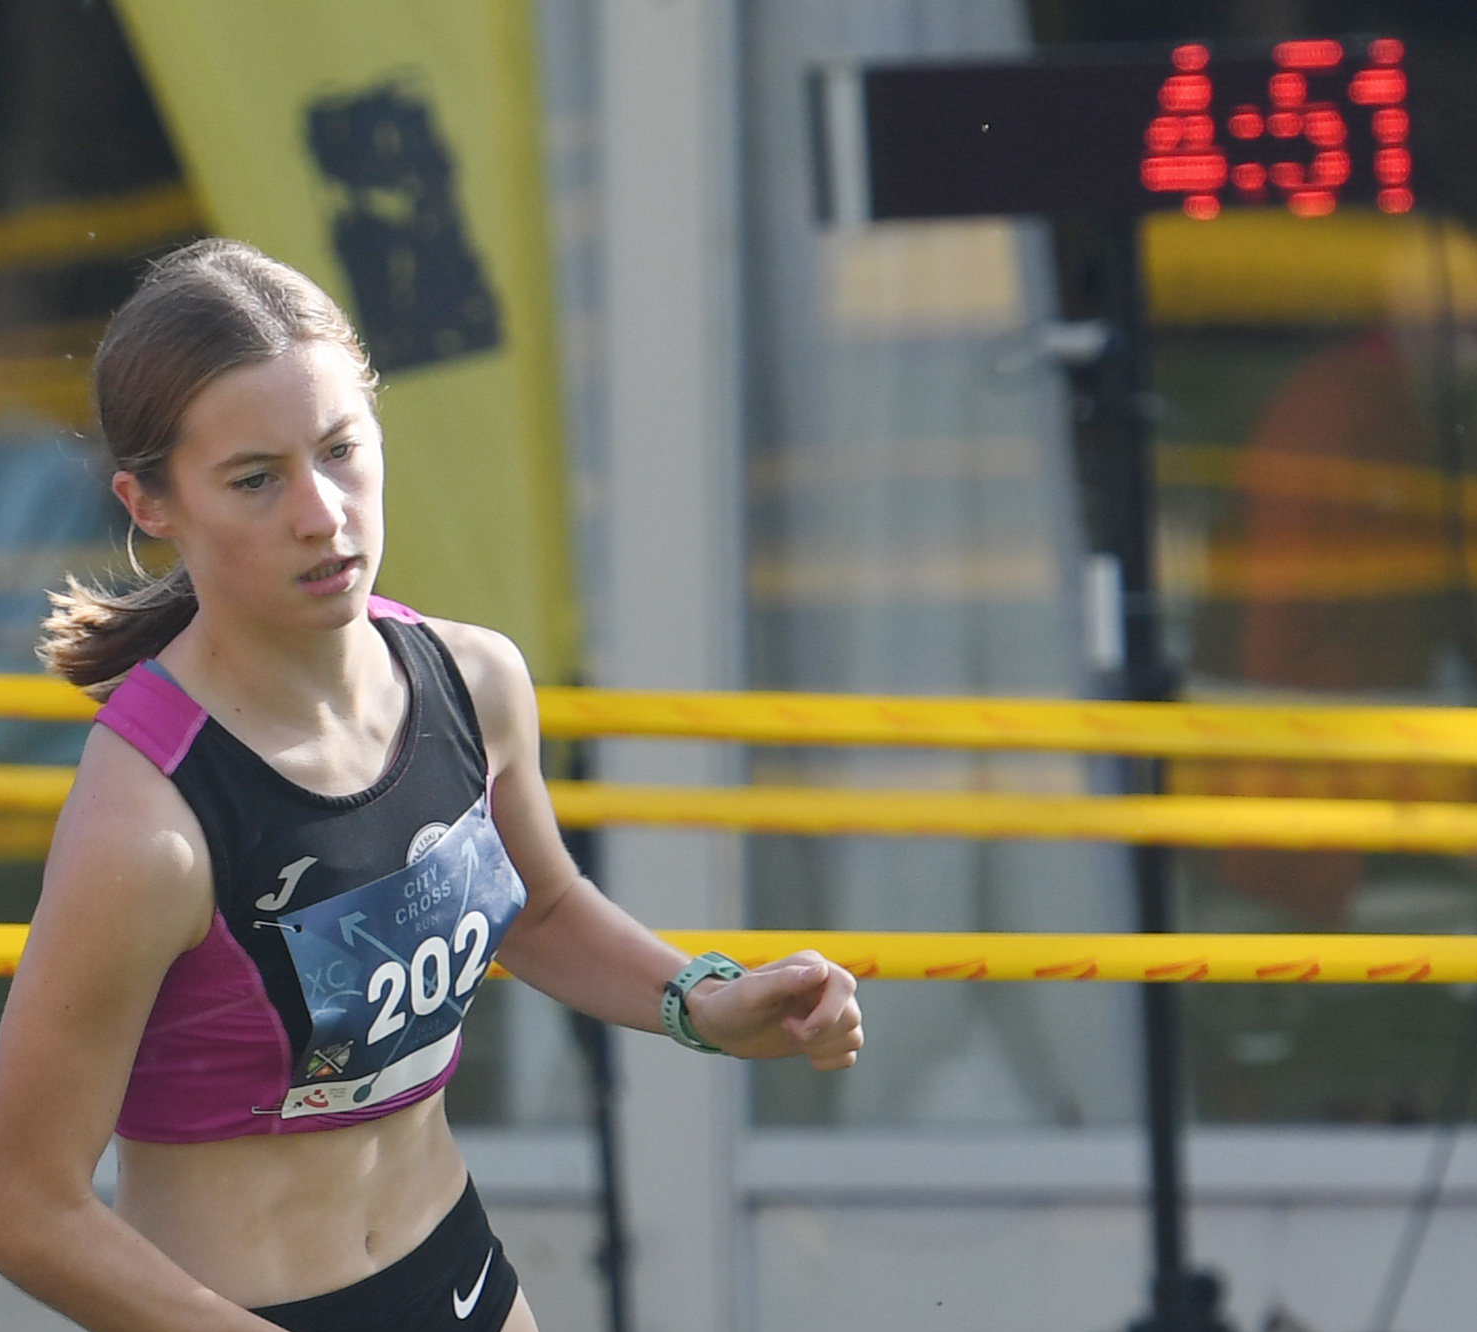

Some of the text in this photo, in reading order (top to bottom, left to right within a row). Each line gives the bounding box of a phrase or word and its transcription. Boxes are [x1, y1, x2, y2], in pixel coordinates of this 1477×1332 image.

[1141, 37, 1414, 220] 4:51
[404, 863, 438, 898] CITY
[395, 880, 451, 925] CROSS
[415, 911, 440, 935] RUN
[305, 960, 346, 999] XC
[367, 911, 490, 1045] 202
